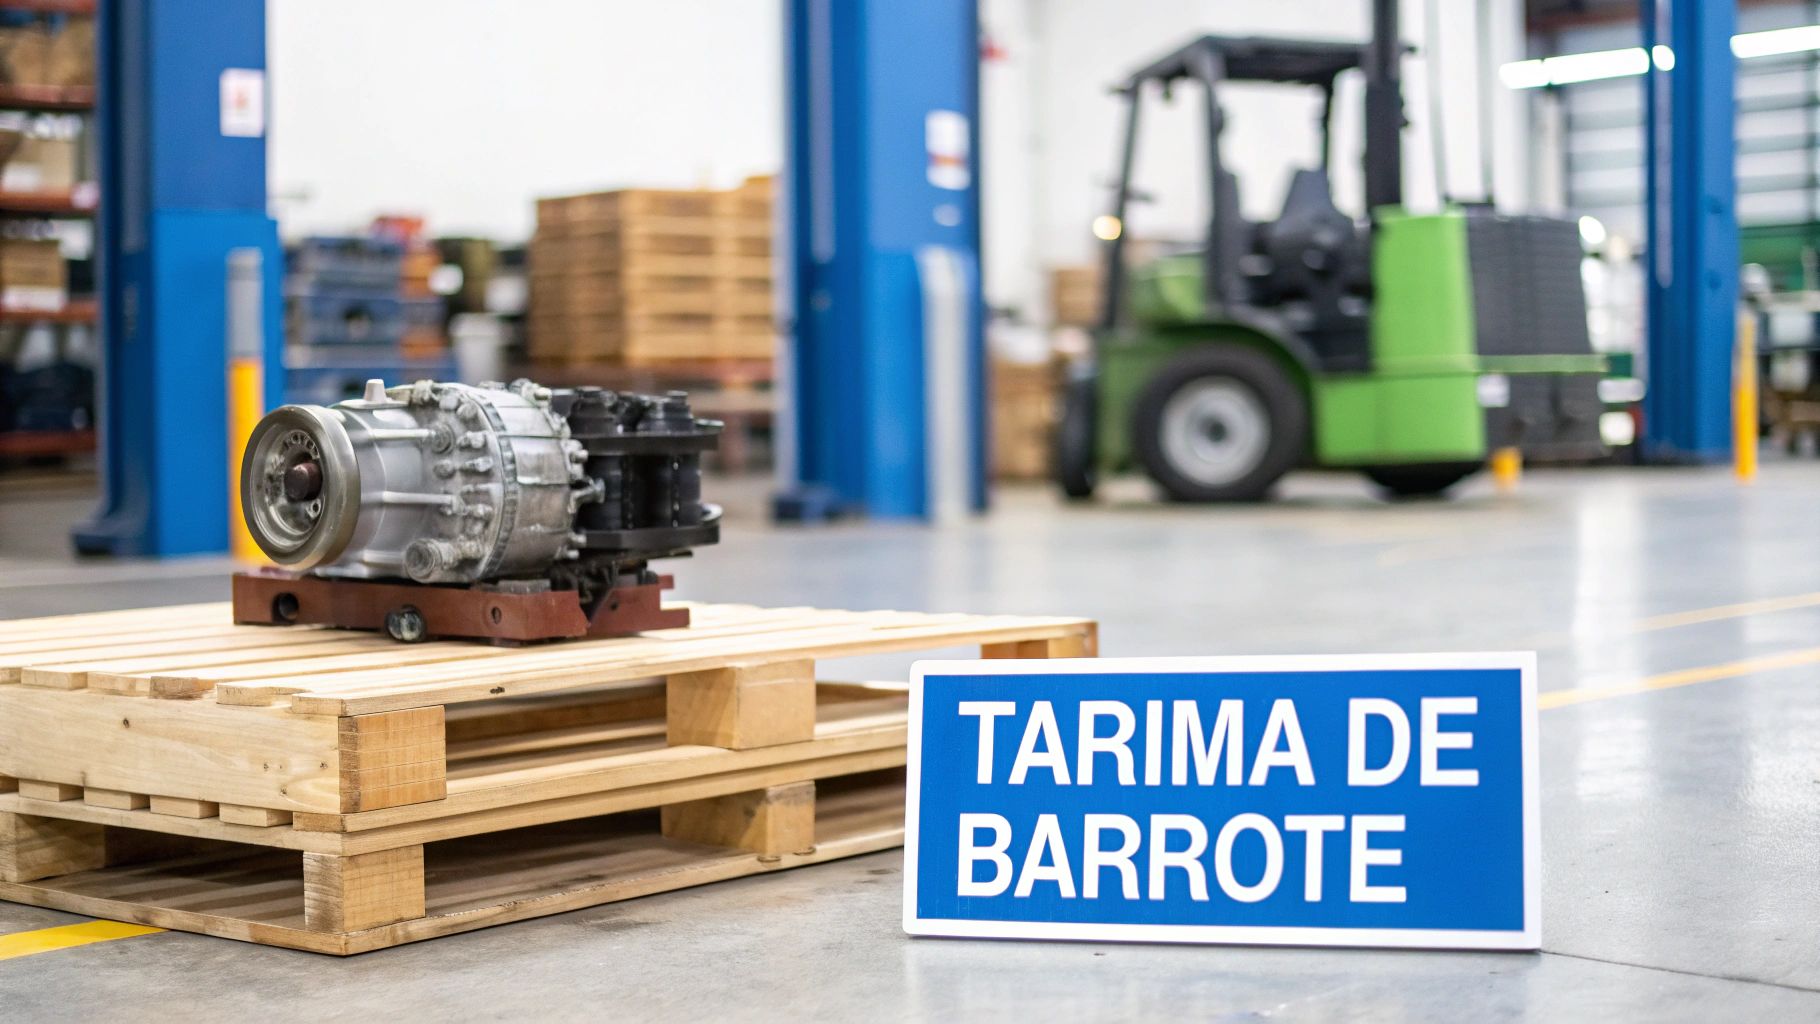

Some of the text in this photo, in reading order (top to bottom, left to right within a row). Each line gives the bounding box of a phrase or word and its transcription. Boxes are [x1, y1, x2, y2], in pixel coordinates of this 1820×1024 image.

[957, 697, 1479, 787] TARIMA DE
[957, 813, 1407, 903] BARROTE
